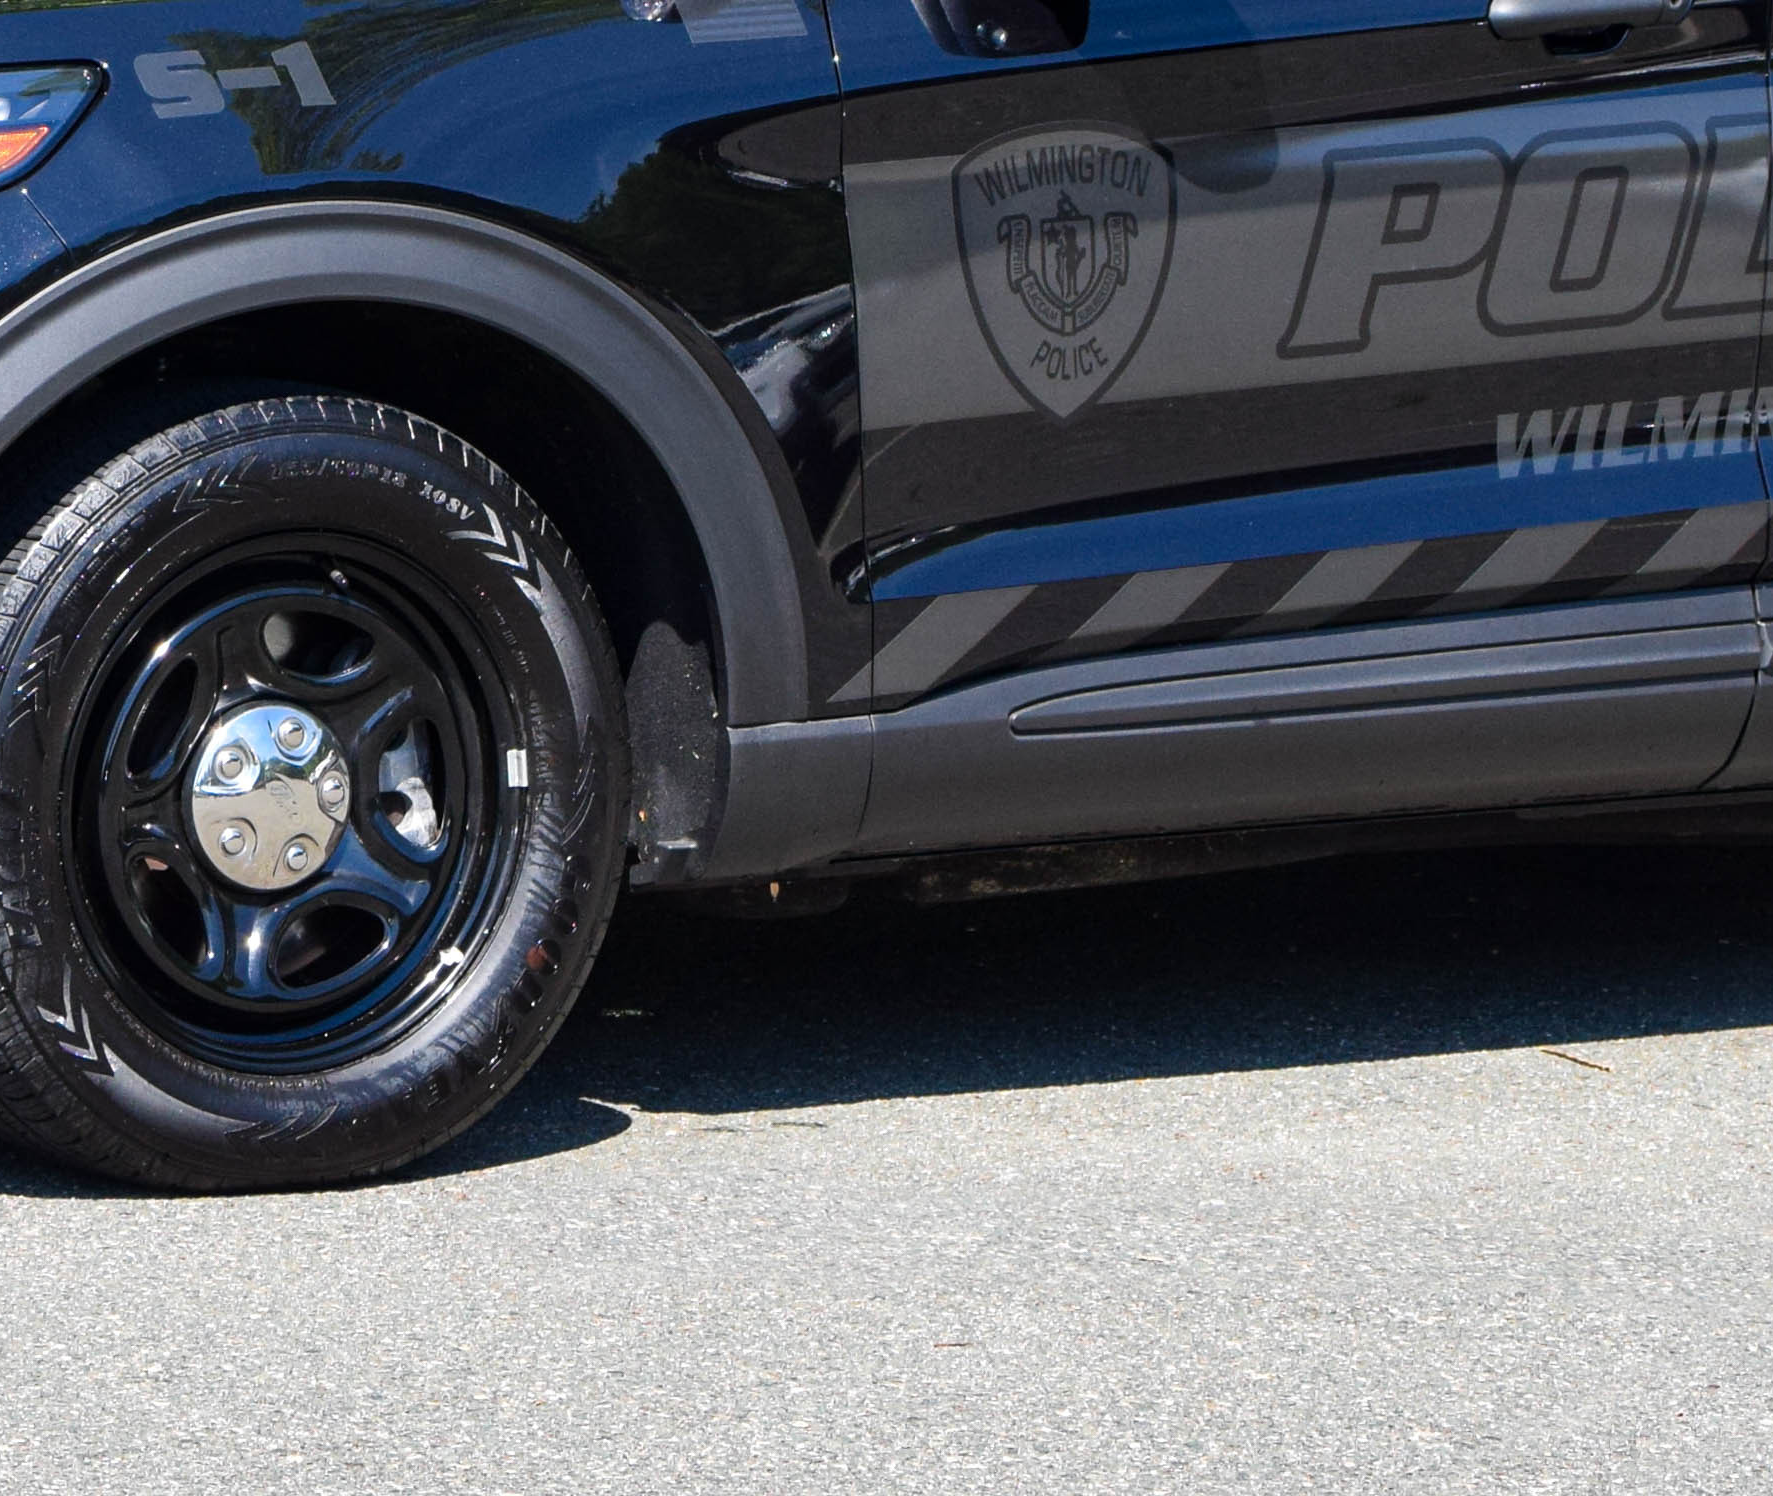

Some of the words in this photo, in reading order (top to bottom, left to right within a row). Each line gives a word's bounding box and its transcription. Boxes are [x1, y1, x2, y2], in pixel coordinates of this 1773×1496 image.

[135, 41, 335, 119] S-1
[975, 145, 1151, 207] WILMINGTON
[1029, 336, 1109, 381] POLICE
